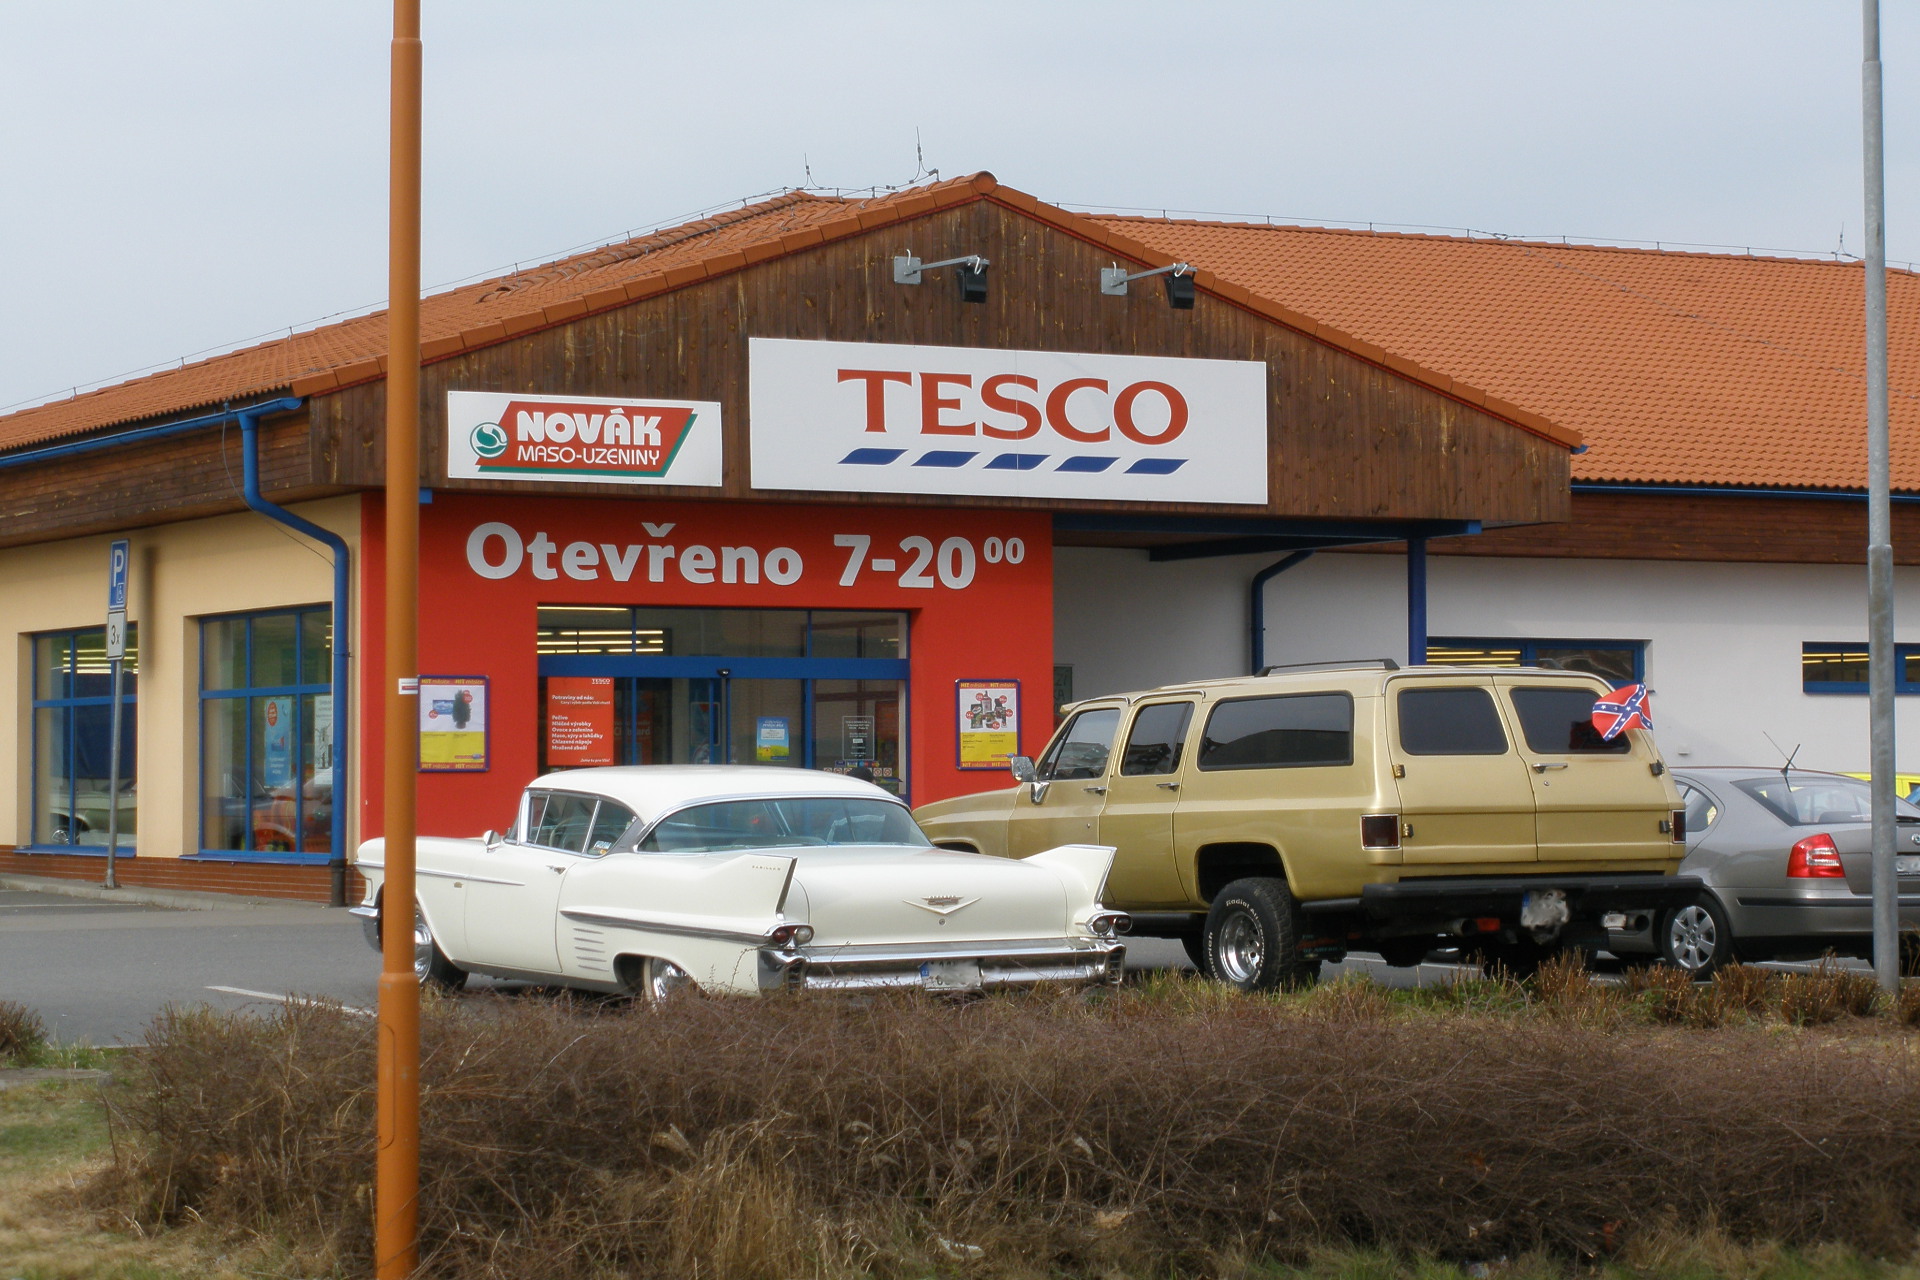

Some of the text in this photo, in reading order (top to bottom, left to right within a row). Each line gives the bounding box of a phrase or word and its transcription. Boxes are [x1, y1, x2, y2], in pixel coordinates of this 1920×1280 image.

[837, 367, 1190, 446] TESCO
[516, 407, 662, 446] NOVÁK
[516, 445, 660, 466] MASO-UZENINY
[113, 549, 124, 587] P
[465, 521, 804, 586] Otevřeno
[110, 625, 120, 646] 3x
[1226, 898, 1250, 909] Radial
